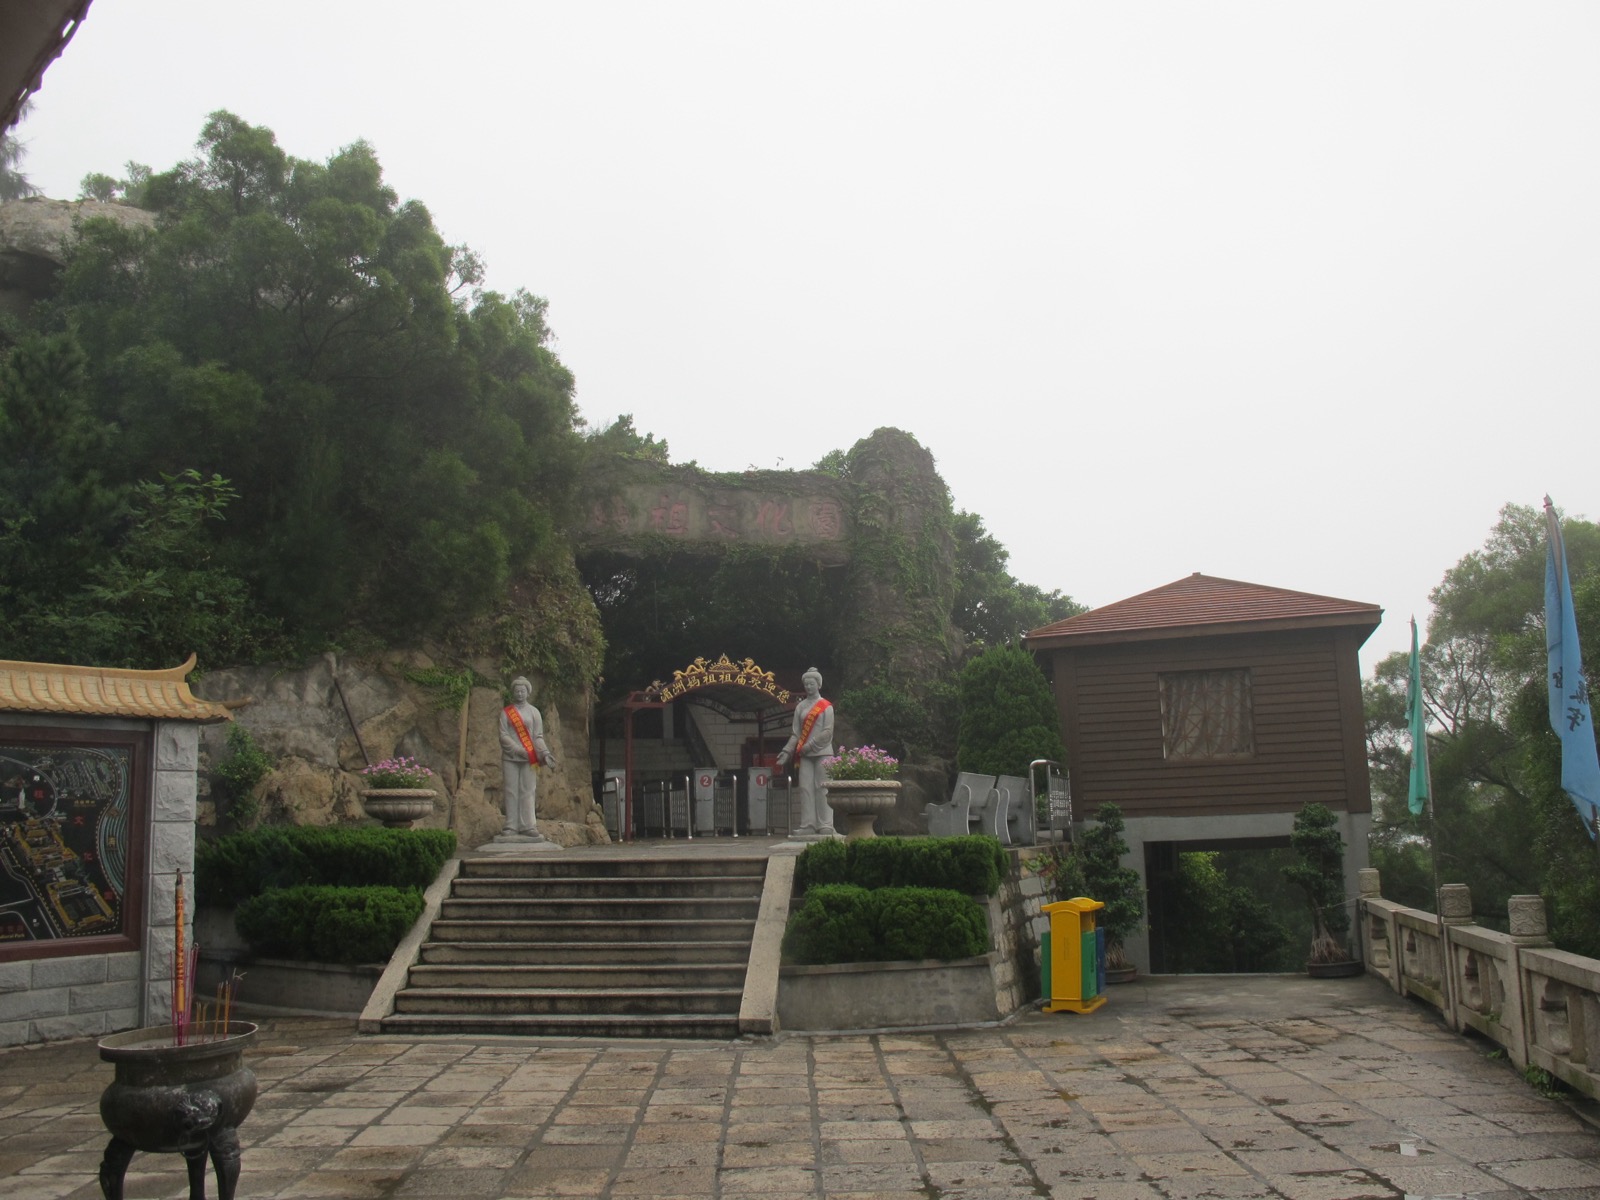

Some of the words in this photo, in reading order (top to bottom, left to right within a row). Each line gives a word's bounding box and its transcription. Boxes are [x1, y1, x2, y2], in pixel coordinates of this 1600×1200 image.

[660, 671, 791, 705] 湄洲妈祖祖庙欢迎您
